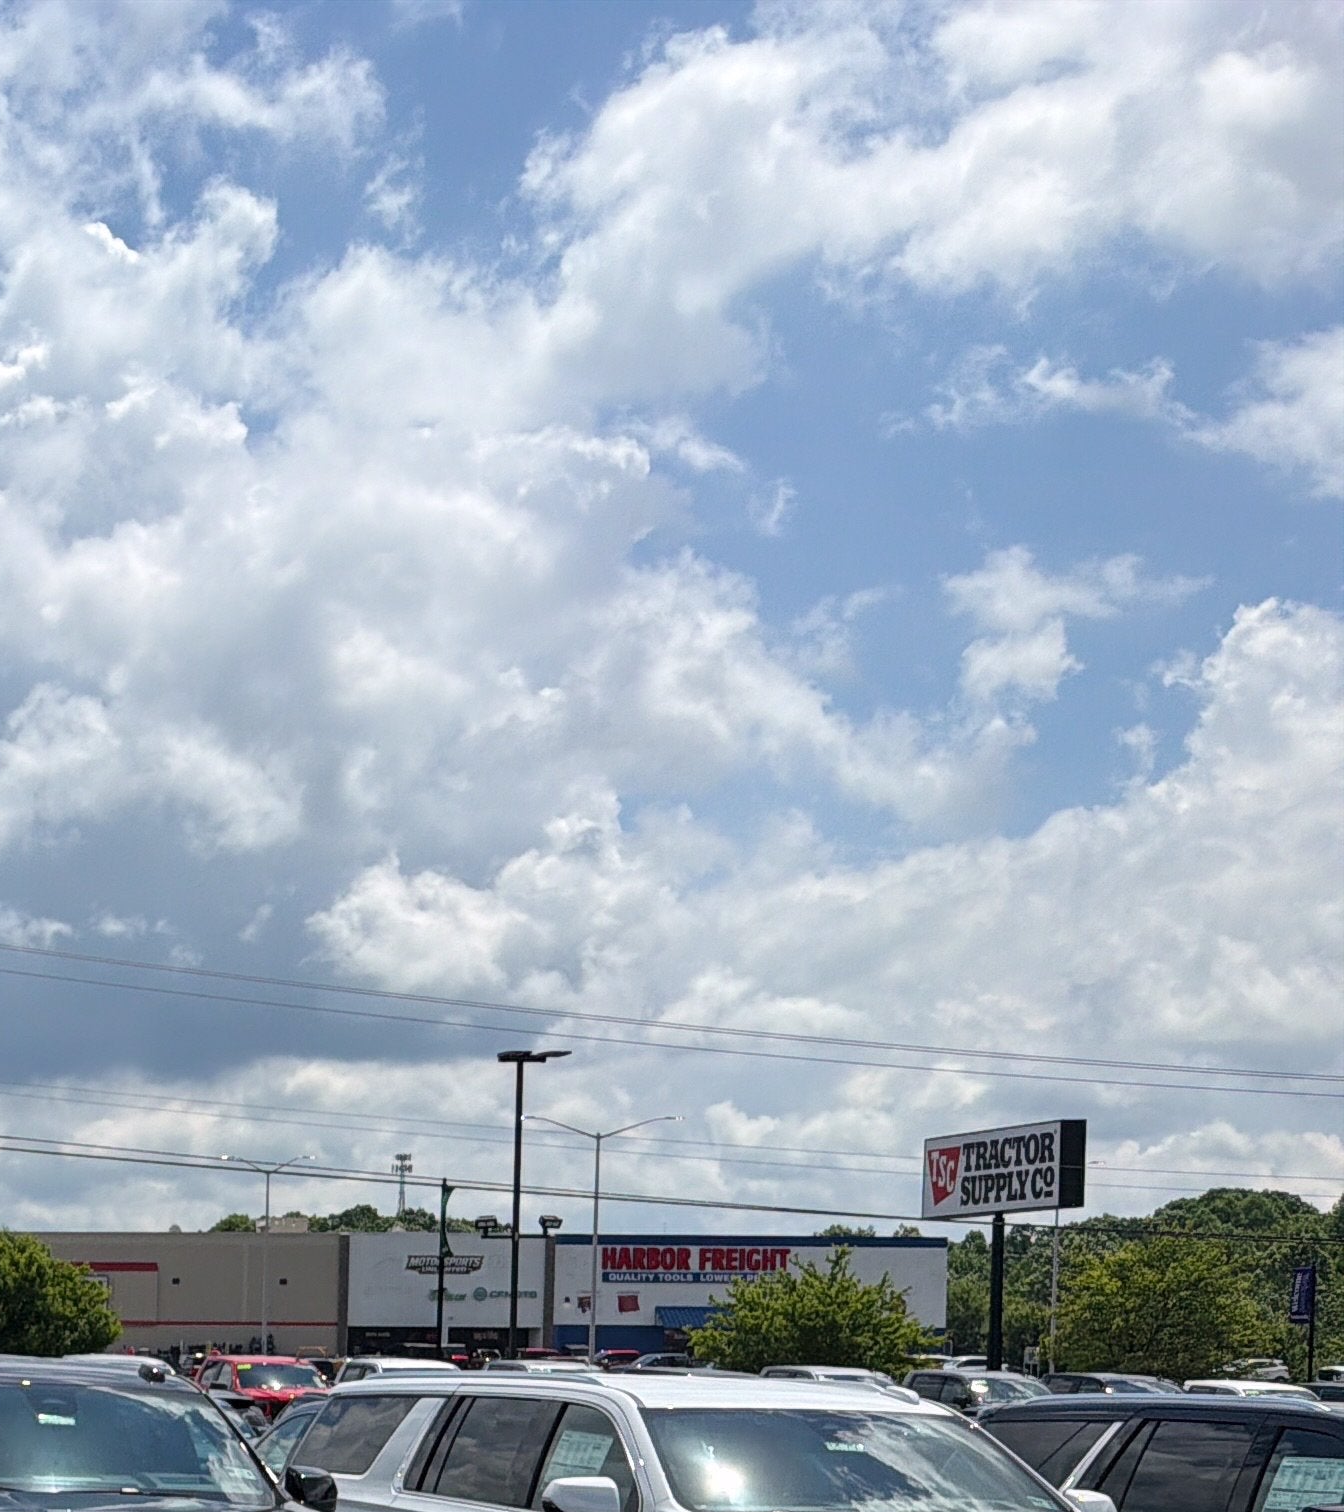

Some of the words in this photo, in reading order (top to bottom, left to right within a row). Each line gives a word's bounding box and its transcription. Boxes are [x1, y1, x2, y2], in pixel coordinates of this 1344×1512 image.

[962, 1132, 1055, 1173] TRACTOR
[930, 1150, 955, 1193] TSC
[960, 1169, 1030, 1206] SUPPLY
[408, 1256, 482, 1267] MOTOSPORTS
[601, 1247, 691, 1271] HARBOR
[698, 1248, 791, 1272] FREIGHT
[608, 1273, 655, 1281] QUALITY
[658, 1273, 693, 1282] TOOLS
